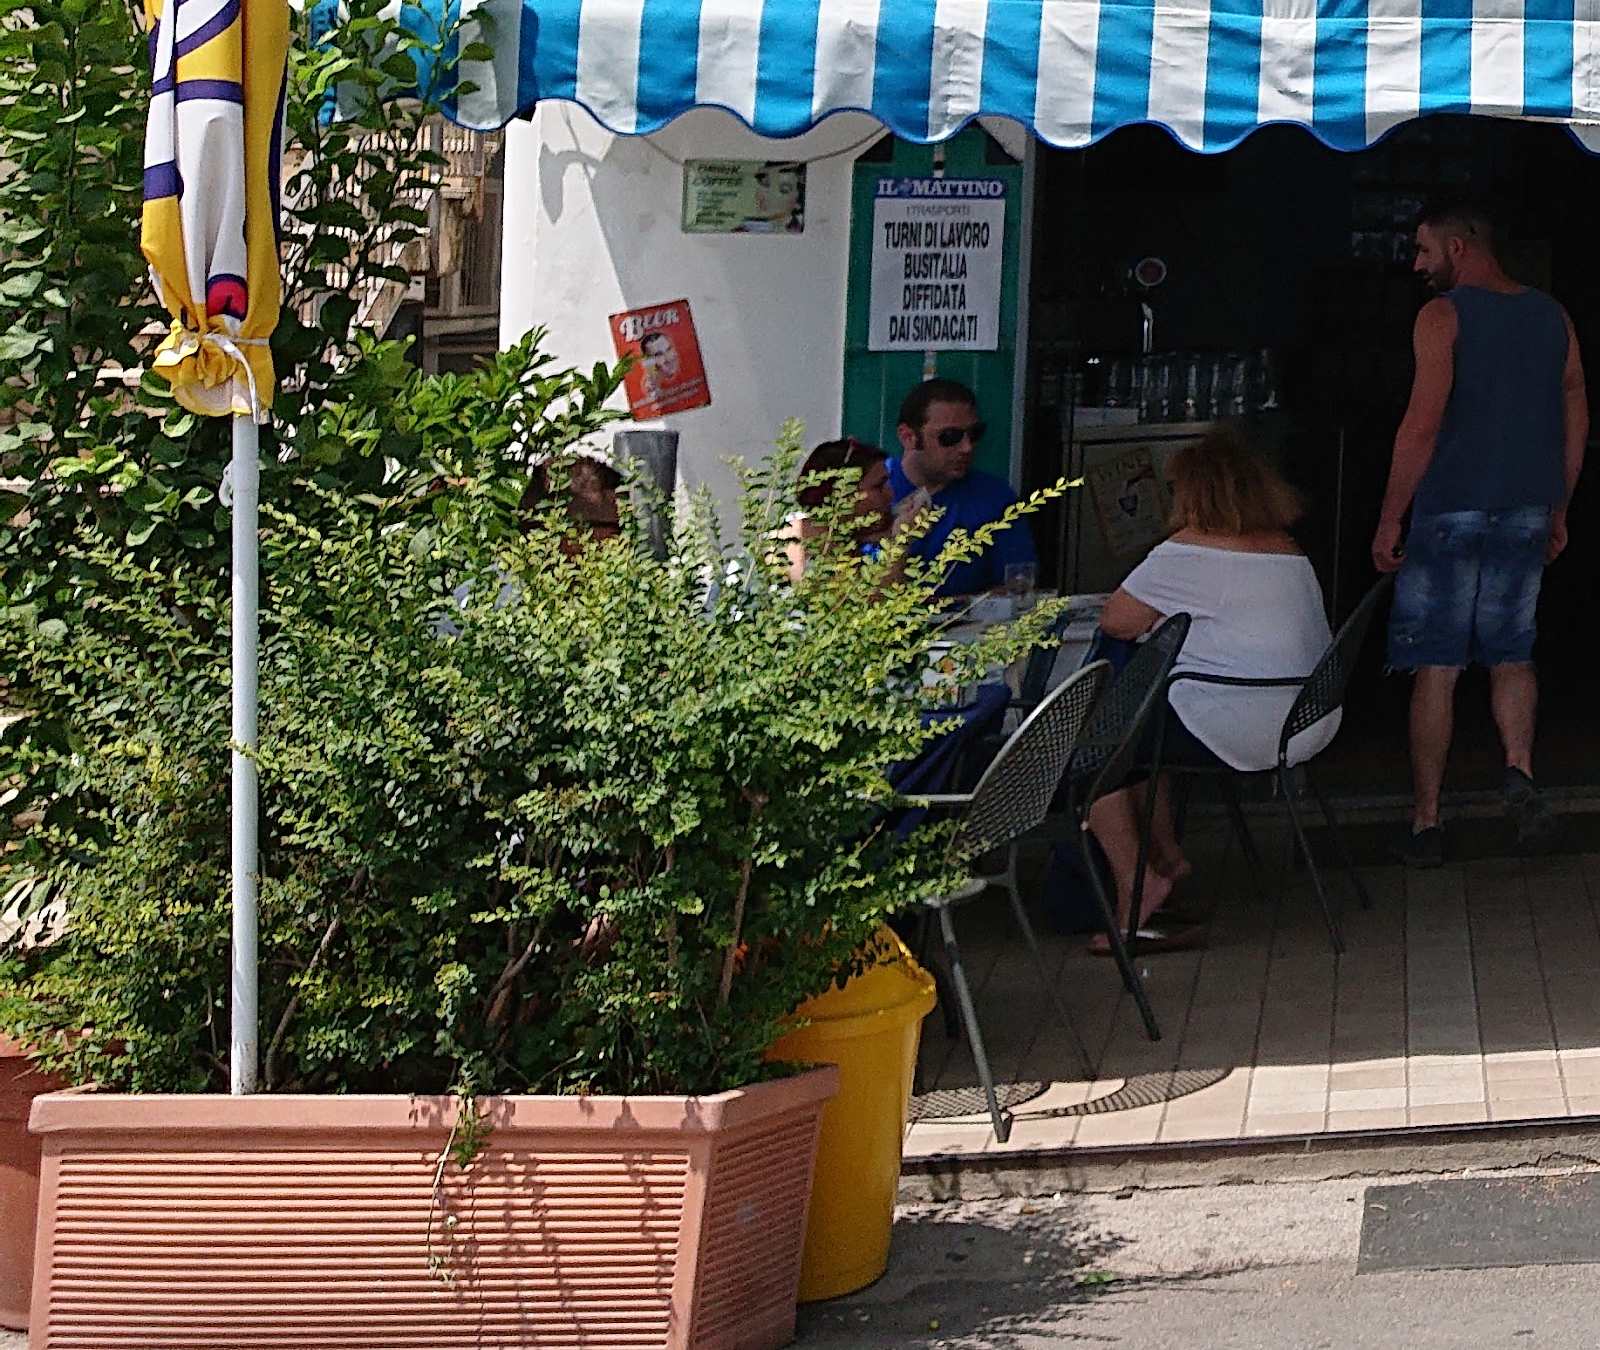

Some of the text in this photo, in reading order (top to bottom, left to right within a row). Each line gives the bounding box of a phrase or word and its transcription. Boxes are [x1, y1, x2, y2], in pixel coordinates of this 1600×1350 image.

[877, 179, 1003, 197] IL MATTINO
[884, 221, 990, 249] TURNI DI LAVORO
[903, 252, 968, 280] BUSITALIA
[902, 283, 967, 311] DIFFIDATA
[620, 308, 680, 343] BEER
[889, 315, 978, 342] DAI SINDACATI
